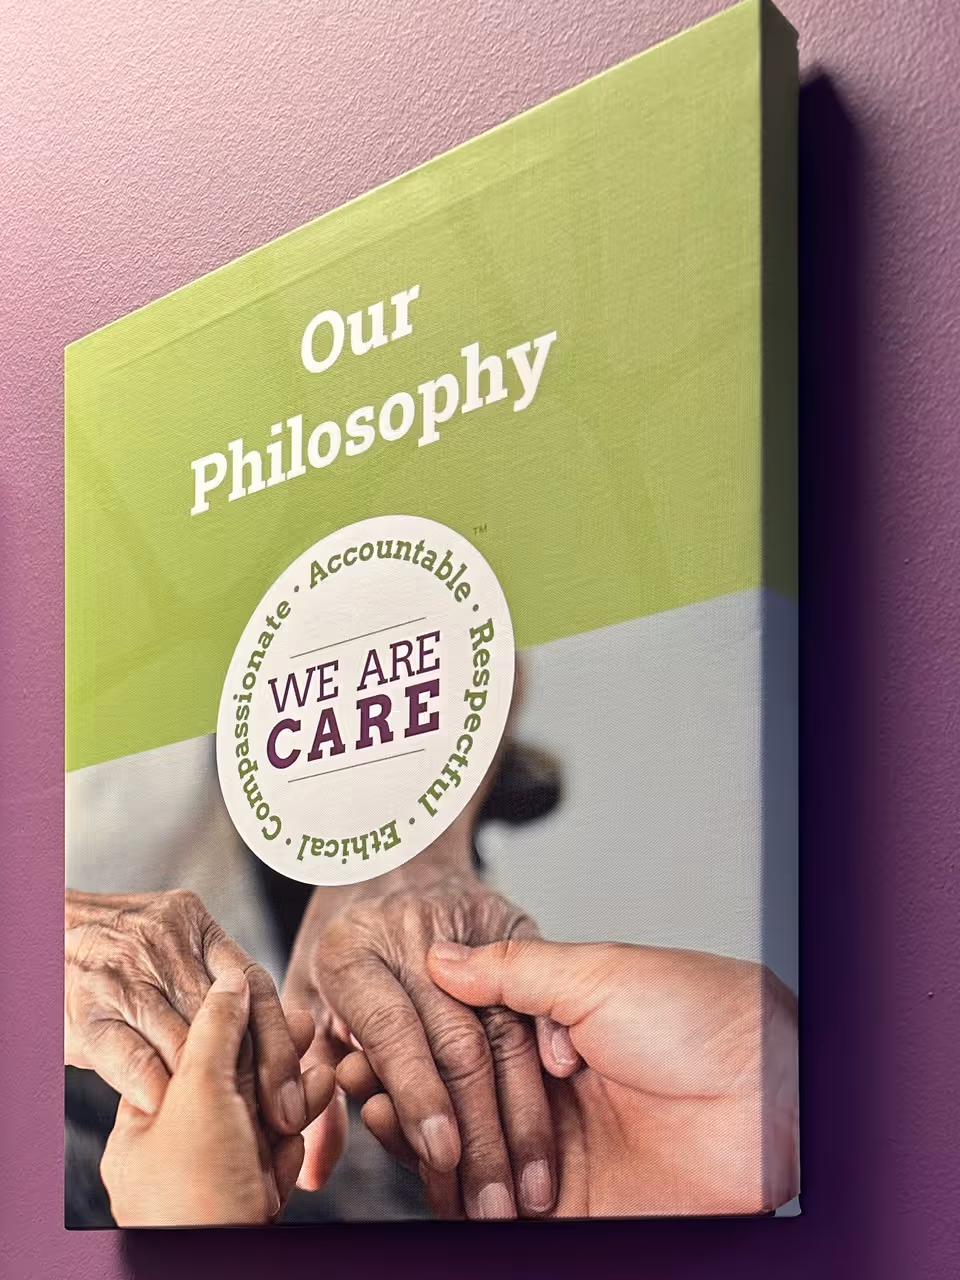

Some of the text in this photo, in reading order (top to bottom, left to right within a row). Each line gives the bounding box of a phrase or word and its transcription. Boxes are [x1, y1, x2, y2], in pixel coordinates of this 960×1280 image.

[300, 285, 420, 373] Our
[190, 331, 557, 516] Philosophy
[233, 538, 495, 864] Accountable Respectful Ethical Compassionate
[268, 630, 441, 714] WE ARE
[266, 678, 441, 769] CARE
